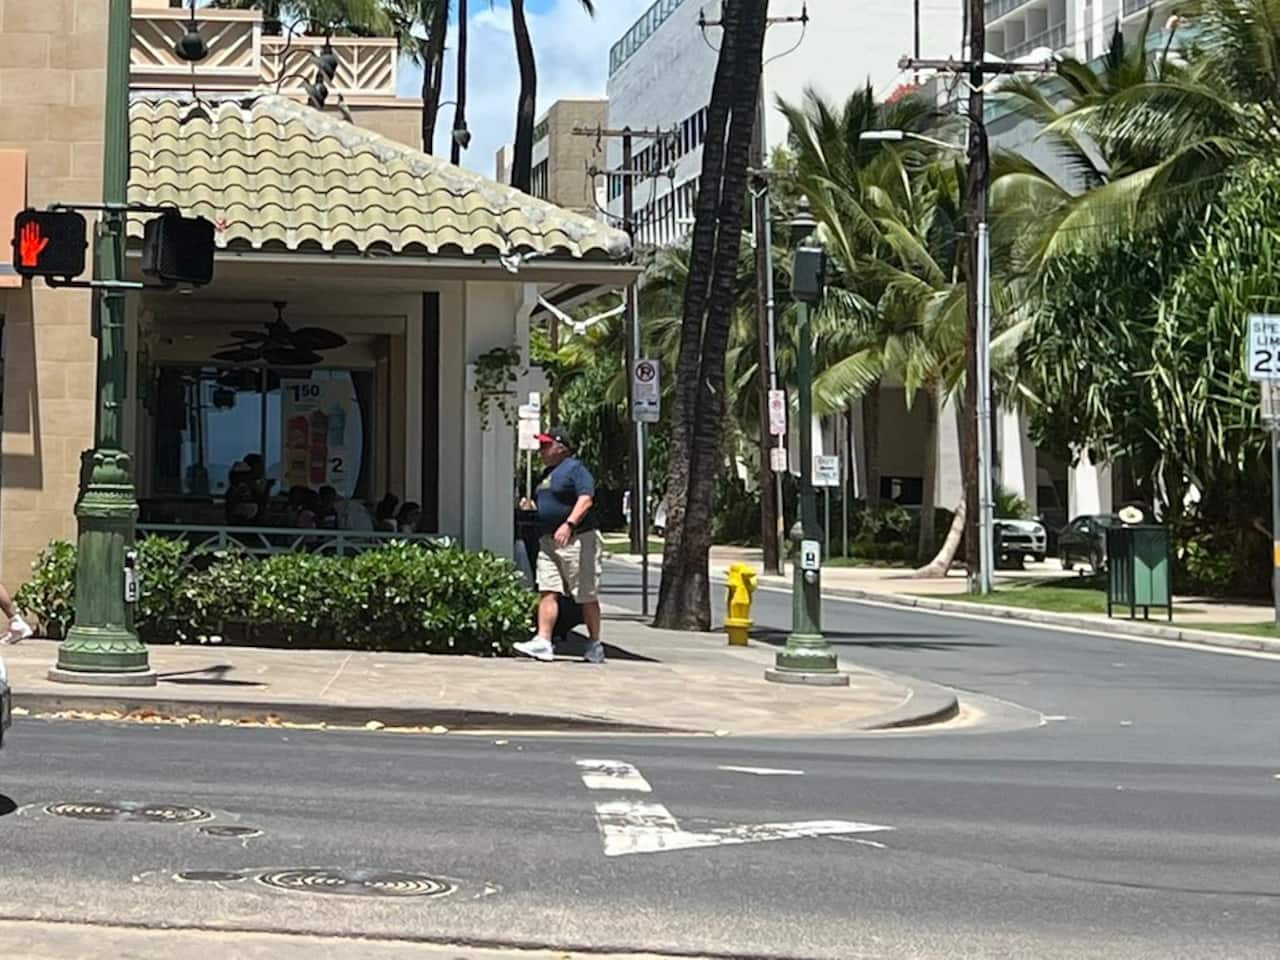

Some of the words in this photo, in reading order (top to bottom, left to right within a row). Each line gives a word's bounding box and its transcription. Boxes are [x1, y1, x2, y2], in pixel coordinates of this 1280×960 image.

[1253, 322, 1280, 334] SPE
[1257, 336, 1280, 346] LIM
[1254, 350, 1280, 373] 2
